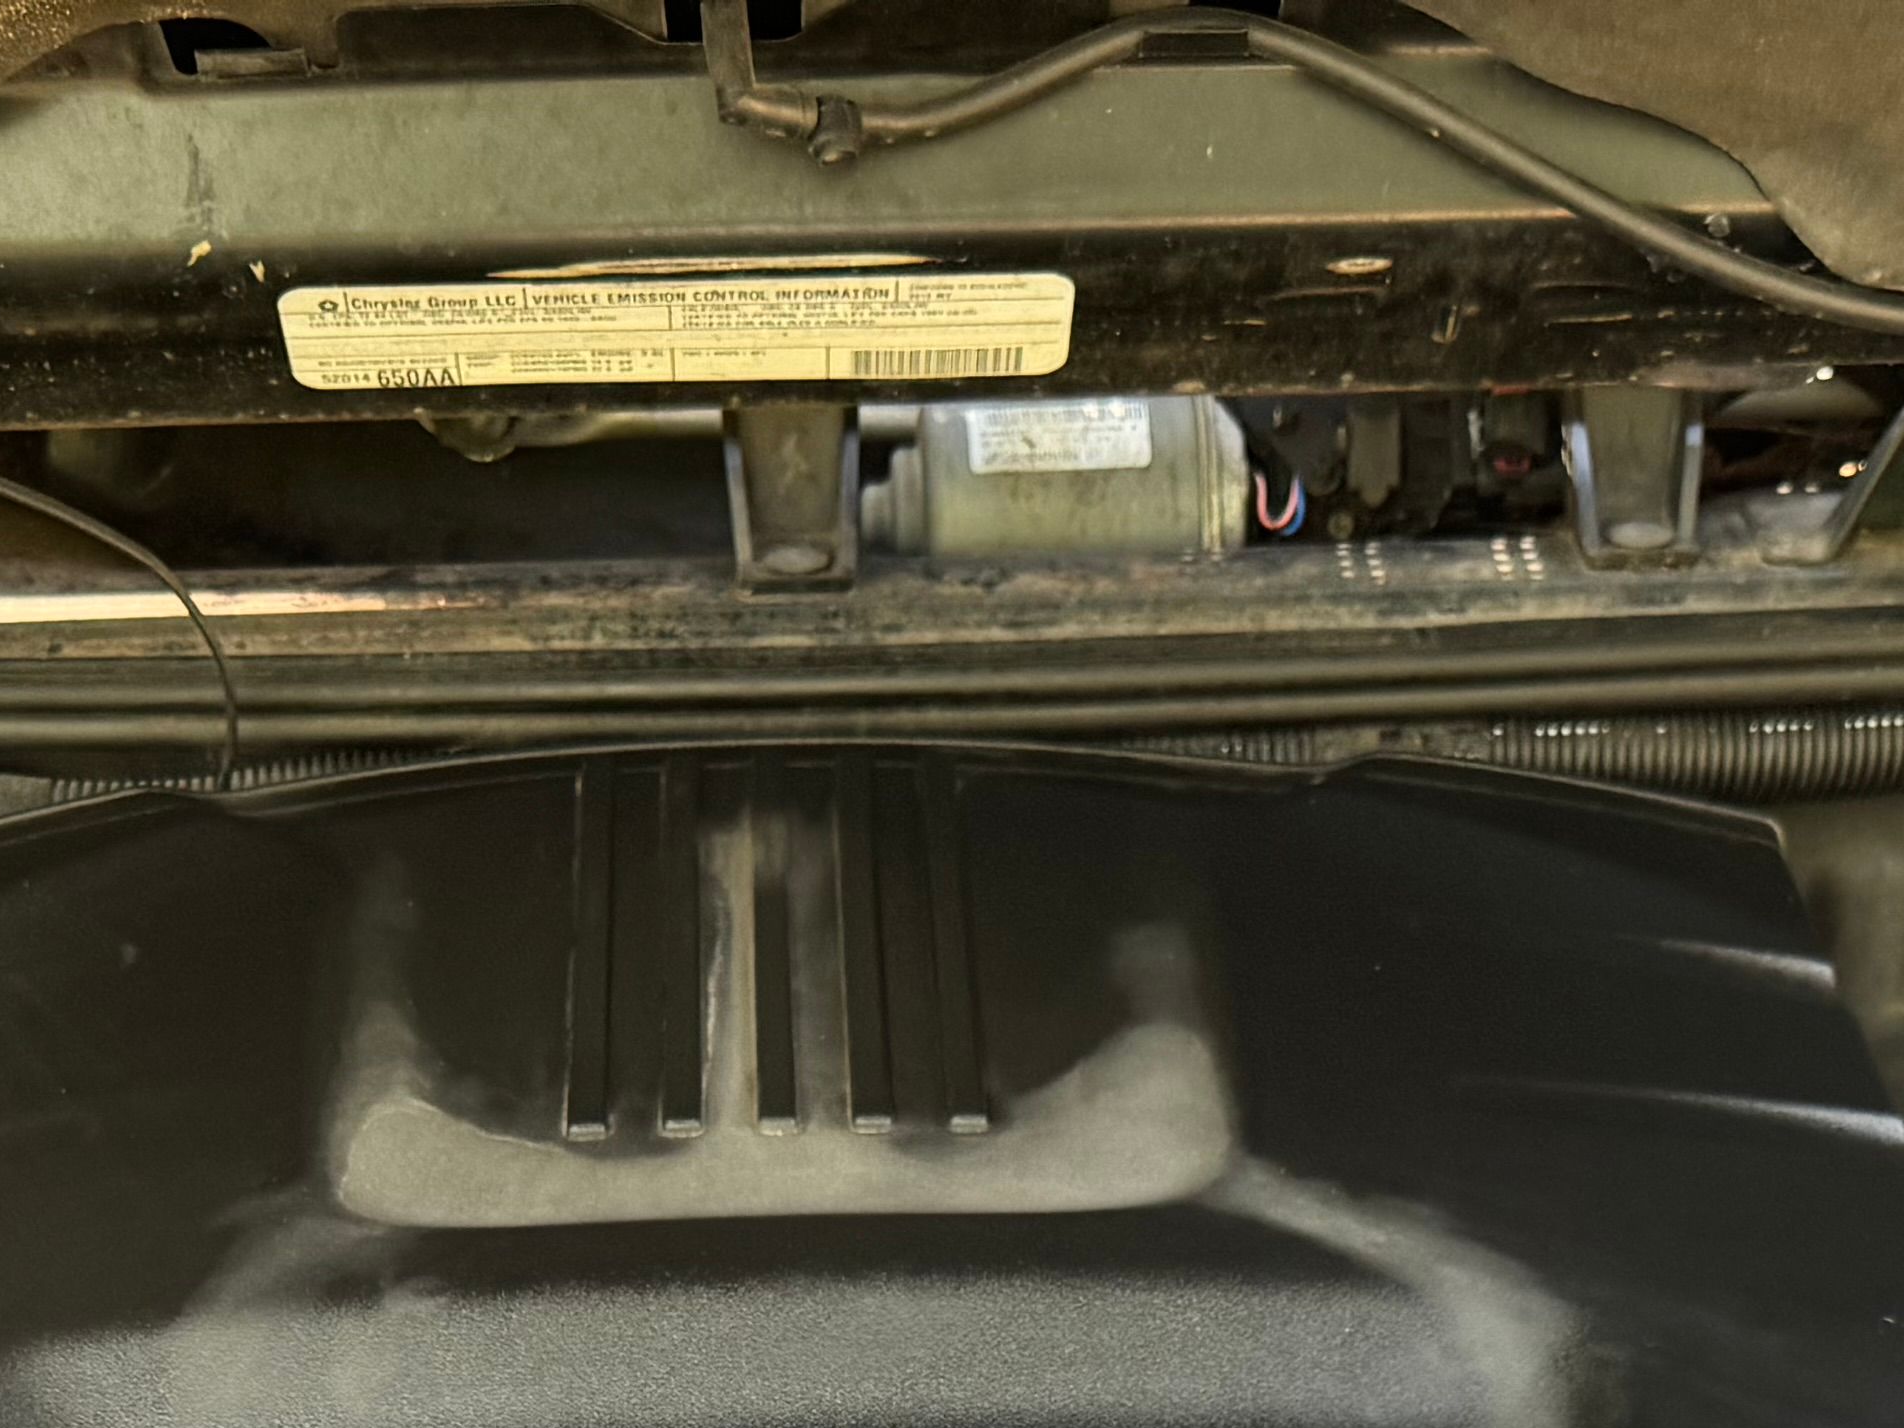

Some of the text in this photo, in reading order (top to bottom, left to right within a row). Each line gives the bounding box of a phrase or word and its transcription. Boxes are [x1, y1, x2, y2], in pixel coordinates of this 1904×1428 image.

[428, 296, 478, 311] Group
[485, 295, 516, 308] LLC
[532, 294, 598, 305] VEHICLE
[607, 292, 686, 305] EMISSION
[693, 290, 769, 303] CONTROL
[776, 288, 890, 301] INFORMATION
[377, 368, 456, 389] 650AA
